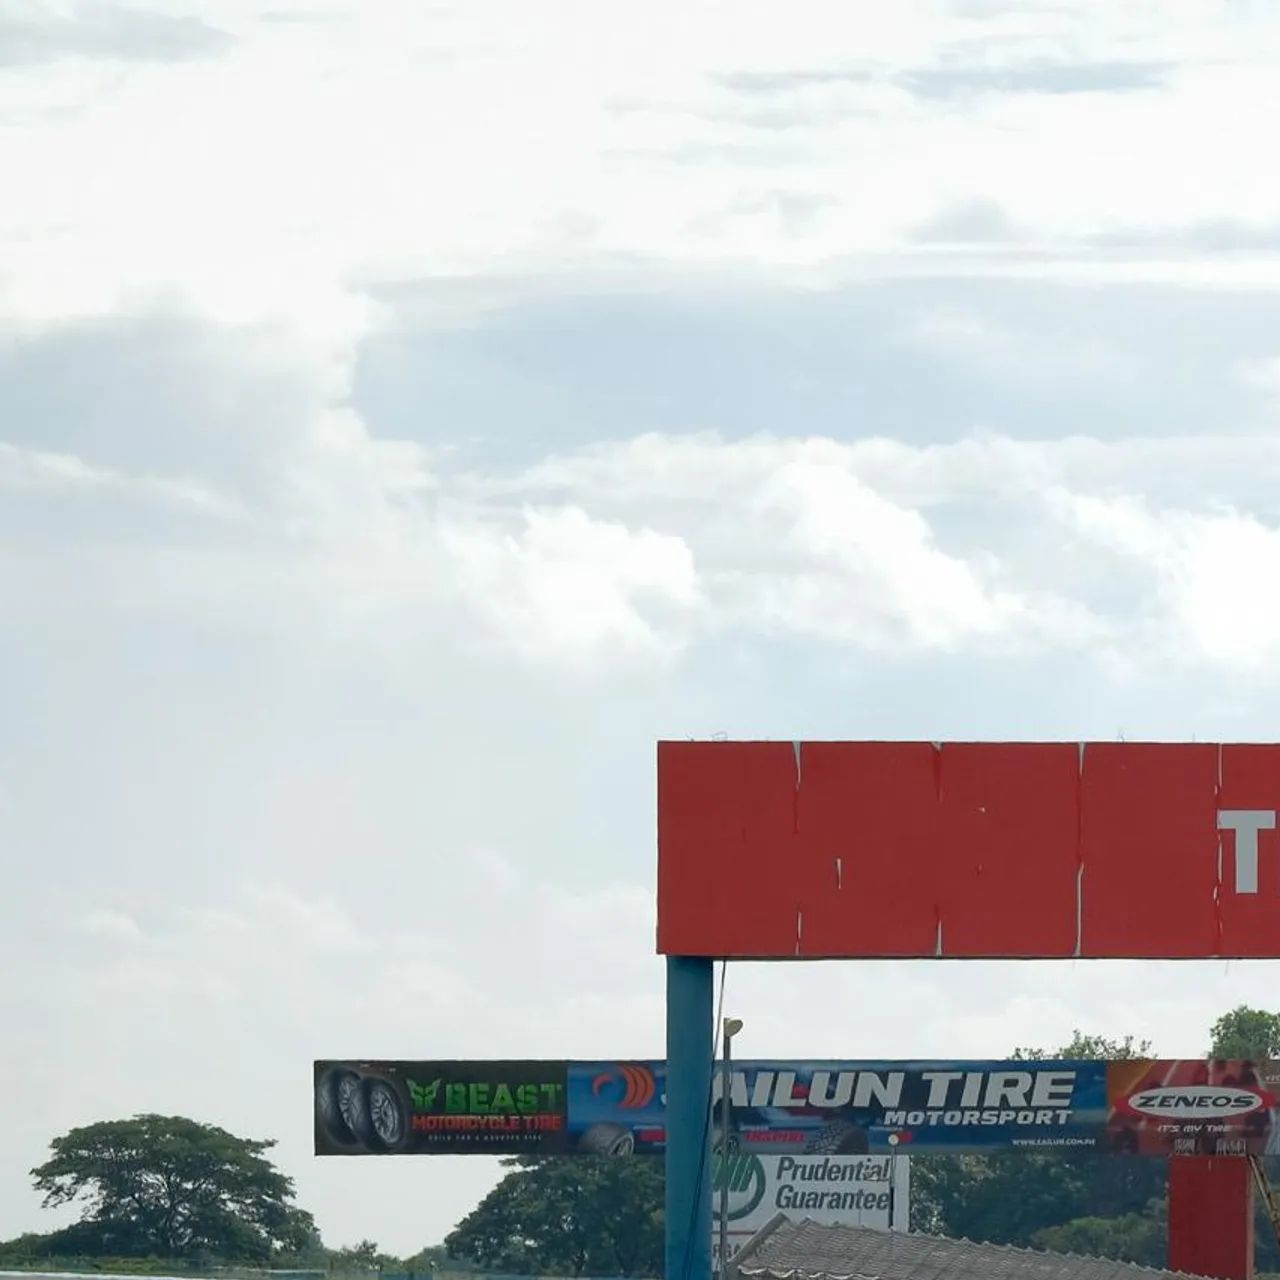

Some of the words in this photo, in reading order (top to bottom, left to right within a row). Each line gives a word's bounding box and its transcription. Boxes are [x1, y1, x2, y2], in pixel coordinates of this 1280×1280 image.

[446, 1082, 562, 1115] BEAST
[653, 1071, 905, 1108] AILUN
[917, 1071, 1076, 1108] TIRE
[1135, 1095, 1257, 1109] ZENEOS
[411, 1114, 520, 1131] MOTORCYCLE
[524, 1114, 563, 1130] TIRE
[883, 1109, 1073, 1126] MOTORSPORT
[776, 1156, 890, 1182] Prudential
[775, 1184, 890, 1211] Guarantee
